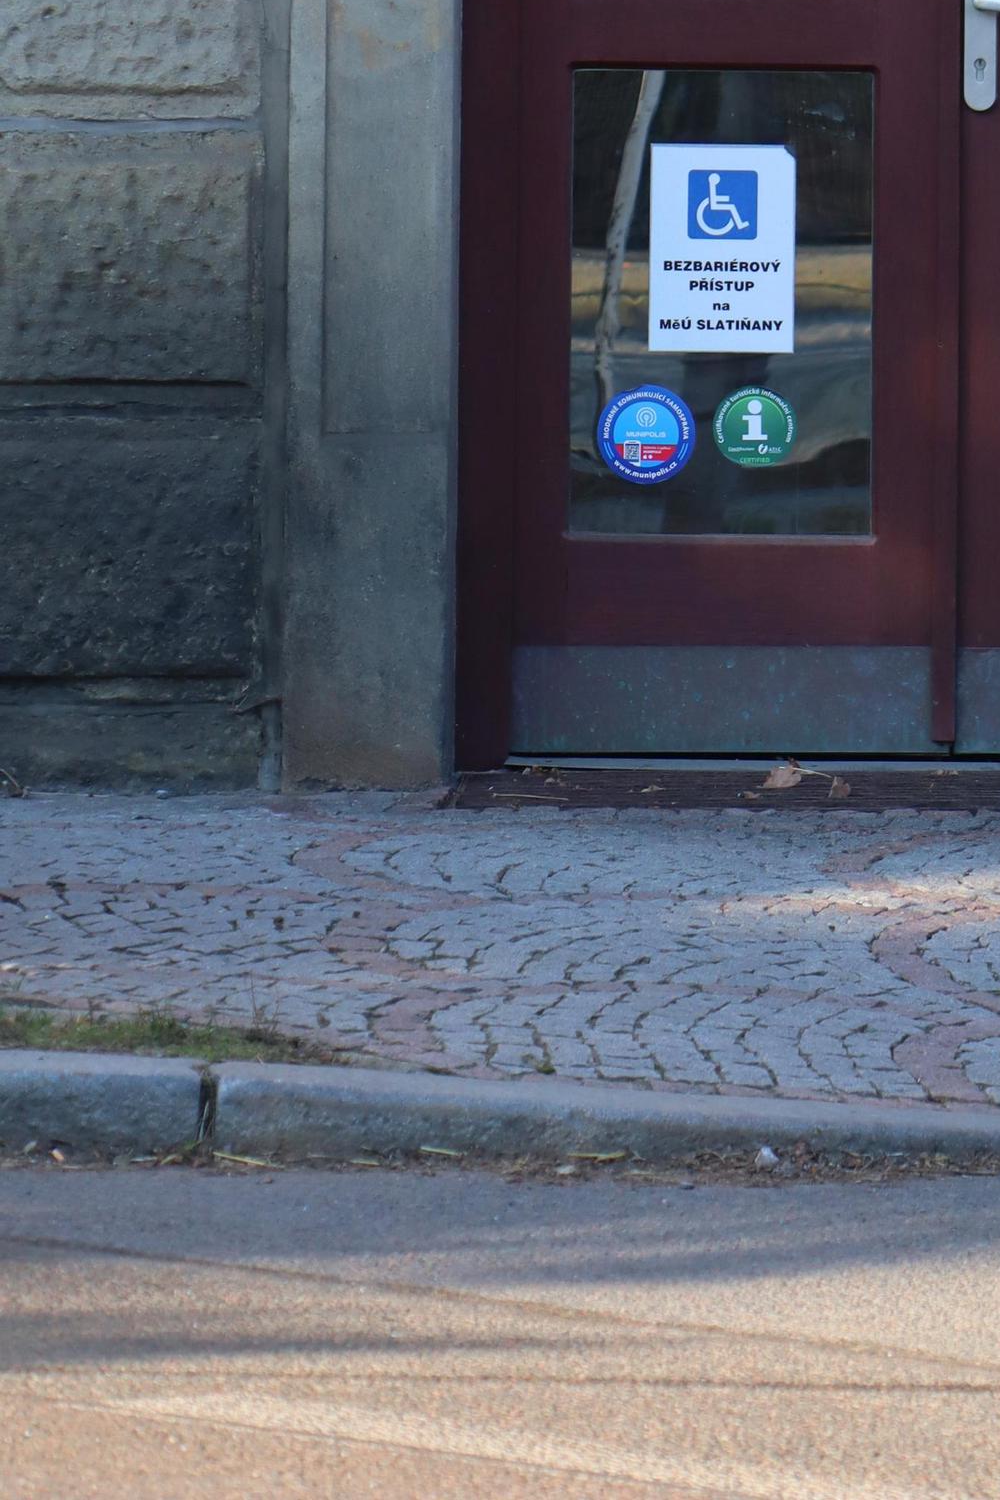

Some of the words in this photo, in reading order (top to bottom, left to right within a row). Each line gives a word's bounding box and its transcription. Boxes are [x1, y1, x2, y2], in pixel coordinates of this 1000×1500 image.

[663, 259, 781, 272] BEZBARIÉROVÝ
[689, 278, 755, 291] PŘÍSTUP
[712, 302, 730, 311] na
[659, 316, 692, 330] MěÚ
[696, 317, 783, 331] SLATIŇANY
[665, 398, 689, 440] SAMOSPRÁVA
[715, 401, 731, 444] Certifikované
[730, 388, 760, 403] turistické
[761, 389, 791, 414] informační
[785, 415, 794, 443] centrum
[613, 460, 678, 480] www.munipolis.cz
